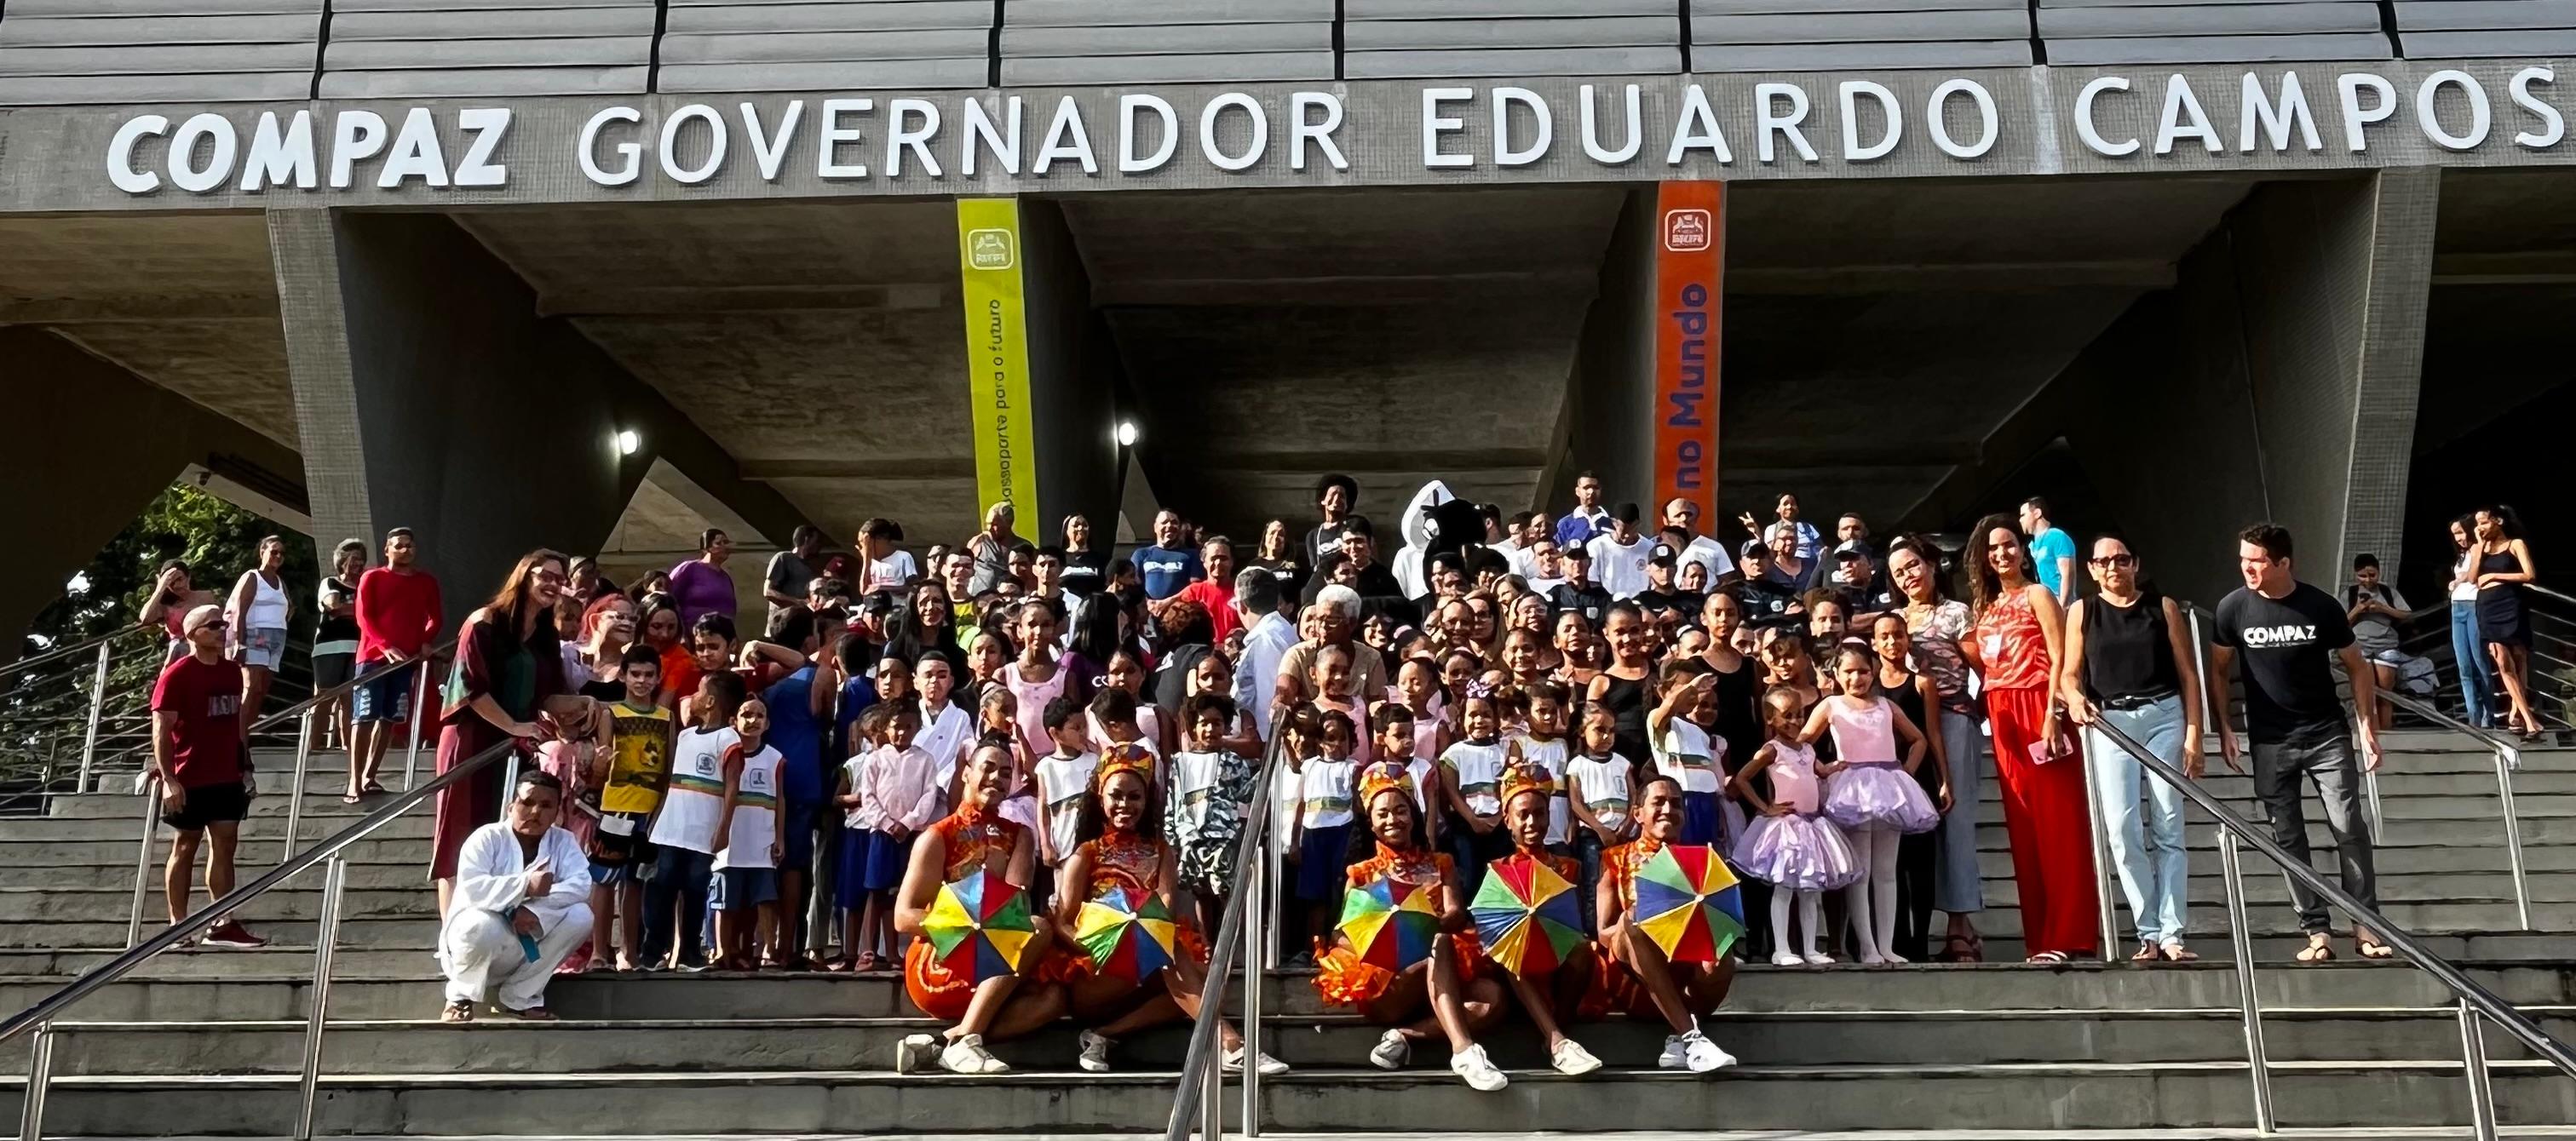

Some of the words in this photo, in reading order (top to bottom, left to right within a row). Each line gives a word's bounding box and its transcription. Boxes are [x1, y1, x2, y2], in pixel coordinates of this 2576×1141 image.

[106, 106, 511, 193] COMPAZ
[578, 91, 1349, 186] GOVERNADOR
[1422, 78, 1999, 166] EDUARDO
[2073, 66, 2566, 156] CAMPOS
[988, 299, 1003, 352] futuro
[993, 357, 1003, 366] o
[1668, 283, 1708, 427] Mundo
[995, 371, 1010, 410] para
[1676, 439, 1702, 489] no
[2243, 625, 2317, 645] COMPAZ
